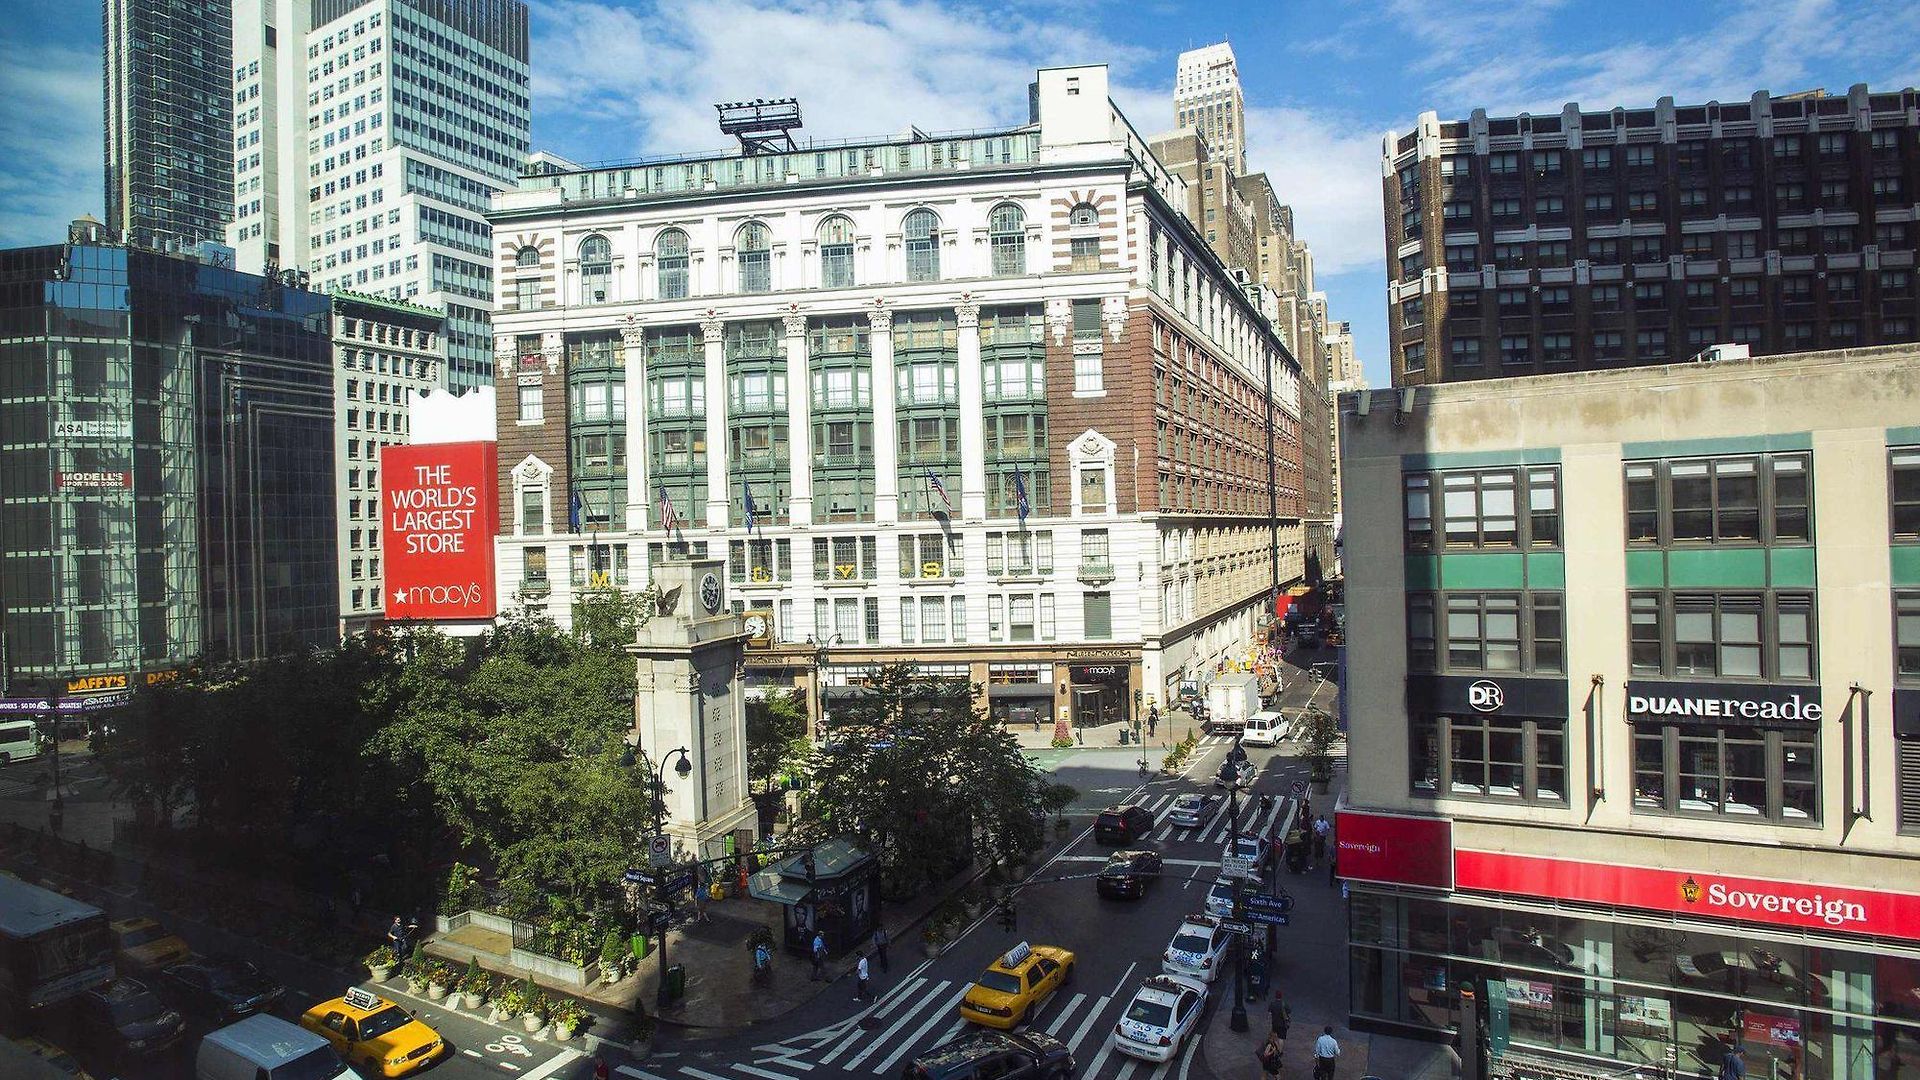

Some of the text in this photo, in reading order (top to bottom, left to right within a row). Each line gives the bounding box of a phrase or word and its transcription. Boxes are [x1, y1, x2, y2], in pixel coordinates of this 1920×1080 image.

[57, 424, 83, 433] ASA
[62, 472, 124, 481] MODELL'S
[414, 465, 451, 485] THE
[391, 487, 477, 509] WORLD'S
[392, 510, 475, 531] LARGEST
[406, 533, 465, 554] STORE
[409, 582, 481, 608] macy's
[1469, 687, 1503, 706] DR
[1339, 841, 1380, 853] Sovereign
[1250, 897, 1267, 906] Sixth
[1708, 883, 1867, 925] Sovereign
